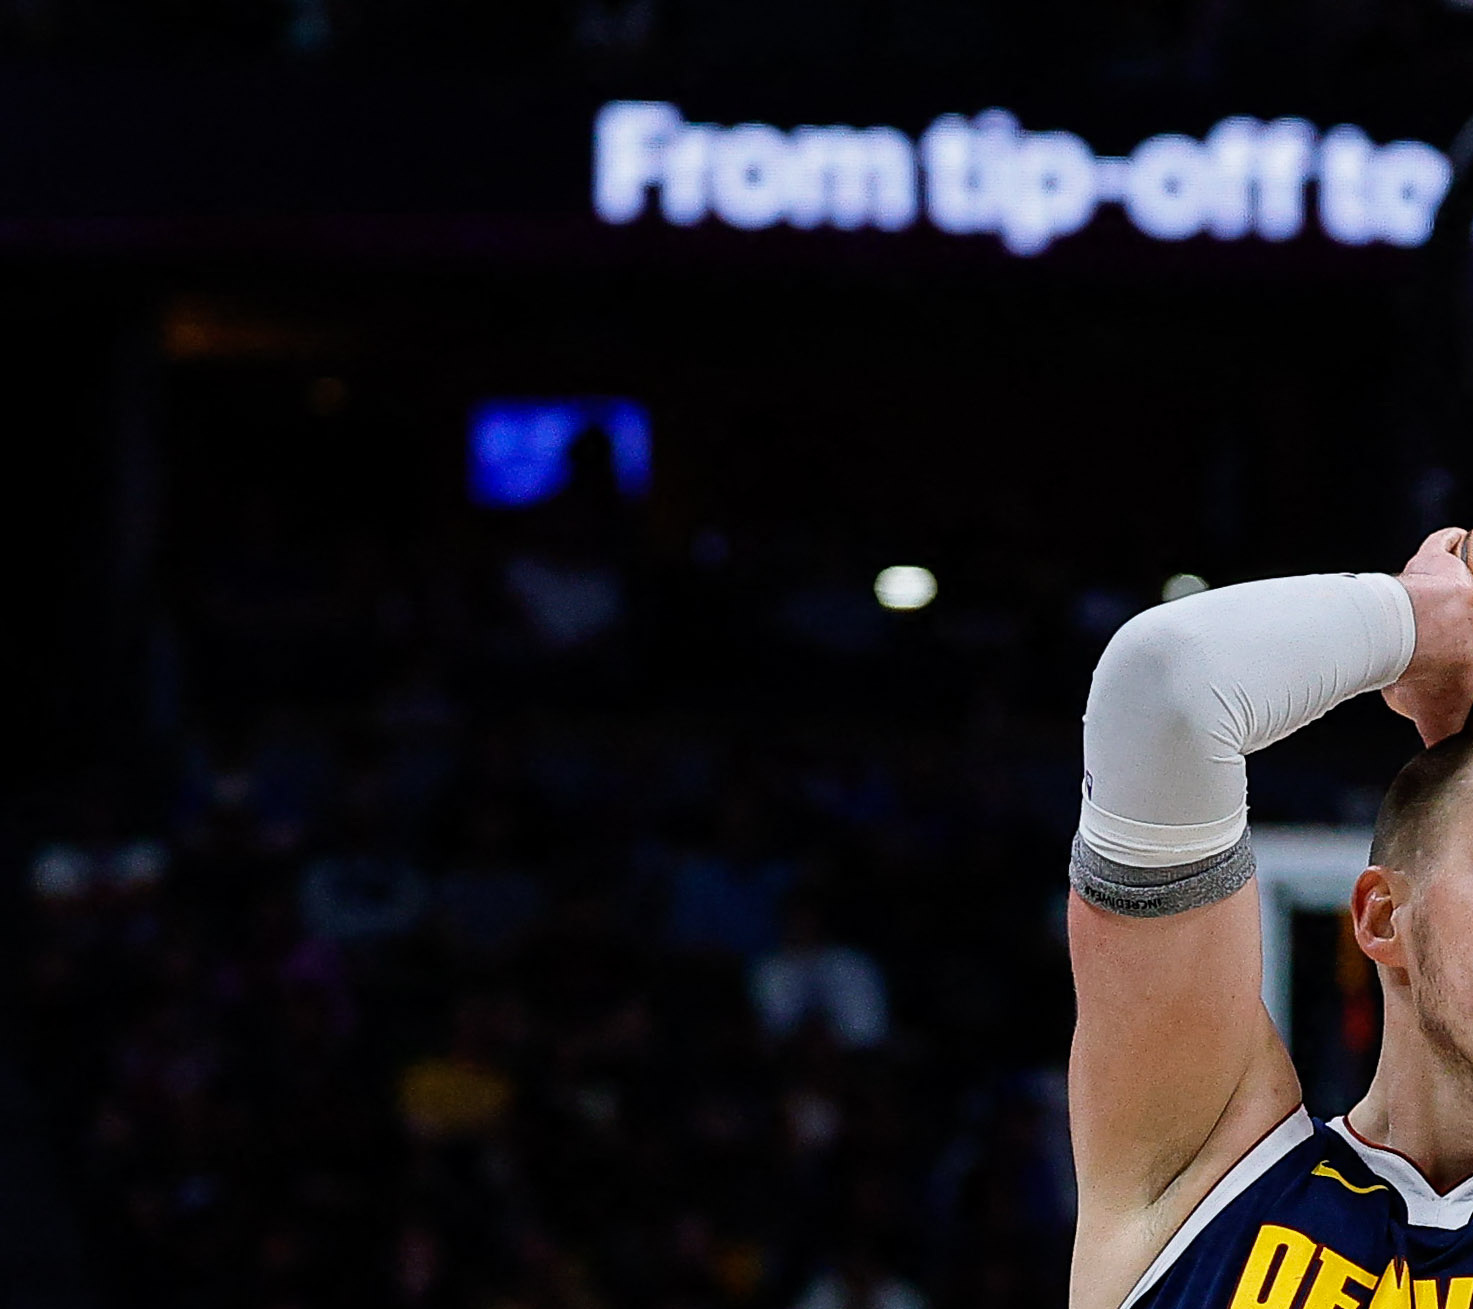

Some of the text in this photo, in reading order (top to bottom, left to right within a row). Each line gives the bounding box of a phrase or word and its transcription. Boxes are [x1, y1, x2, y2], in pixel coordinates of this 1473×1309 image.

[594, 100, 918, 230] From
[920, 107, 1316, 256] tip-off
[1319, 124, 1452, 249] to
